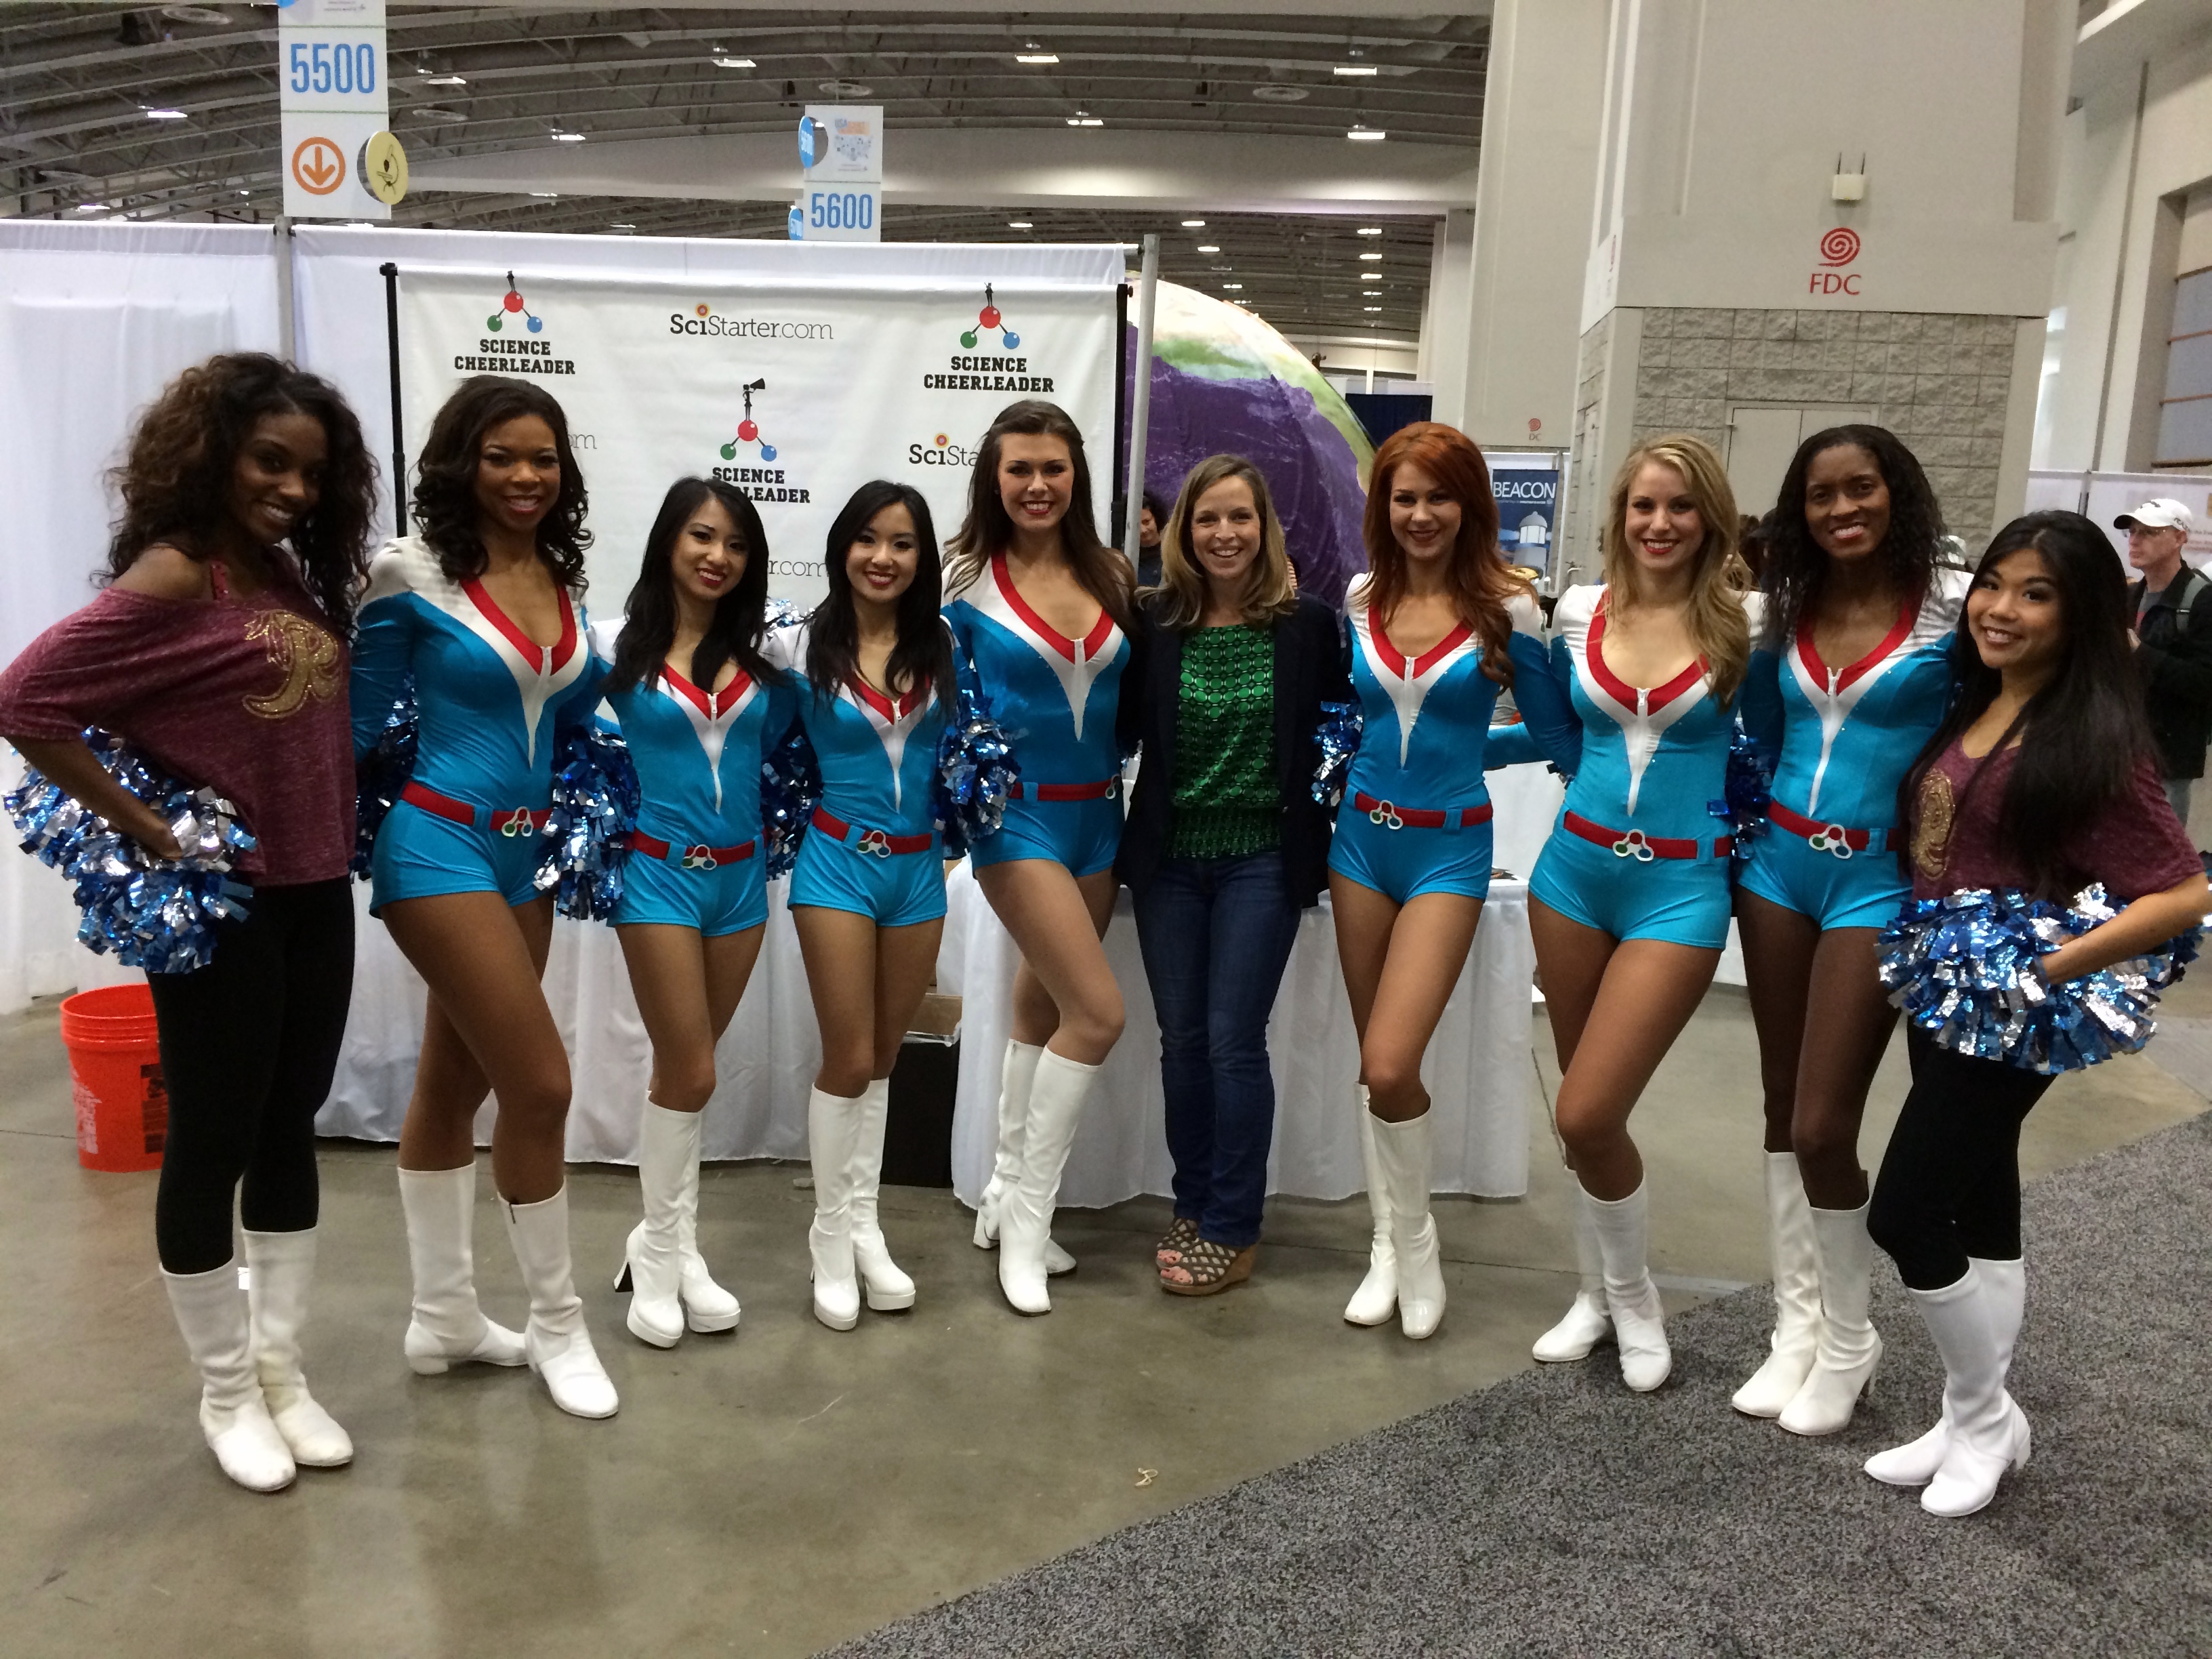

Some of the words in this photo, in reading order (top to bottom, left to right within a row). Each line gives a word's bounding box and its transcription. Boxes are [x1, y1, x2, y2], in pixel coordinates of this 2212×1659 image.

[291, 43, 375, 94] 5500
[811, 193, 873, 229] 5600
[1809, 273, 1862, 295] FDC
[670, 303, 834, 340] SciStarter.com
[480, 339, 550, 355] SCIENCE
[455, 356, 575, 374] CHEERLEADER
[951, 356, 1027, 373] SCIENCE
[924, 374, 1054, 392] CHEERLEADER
[712, 467, 785, 484] SCIENCE
[743, 487, 811, 504] LEADER
[1493, 482, 1556, 498] BEACON
